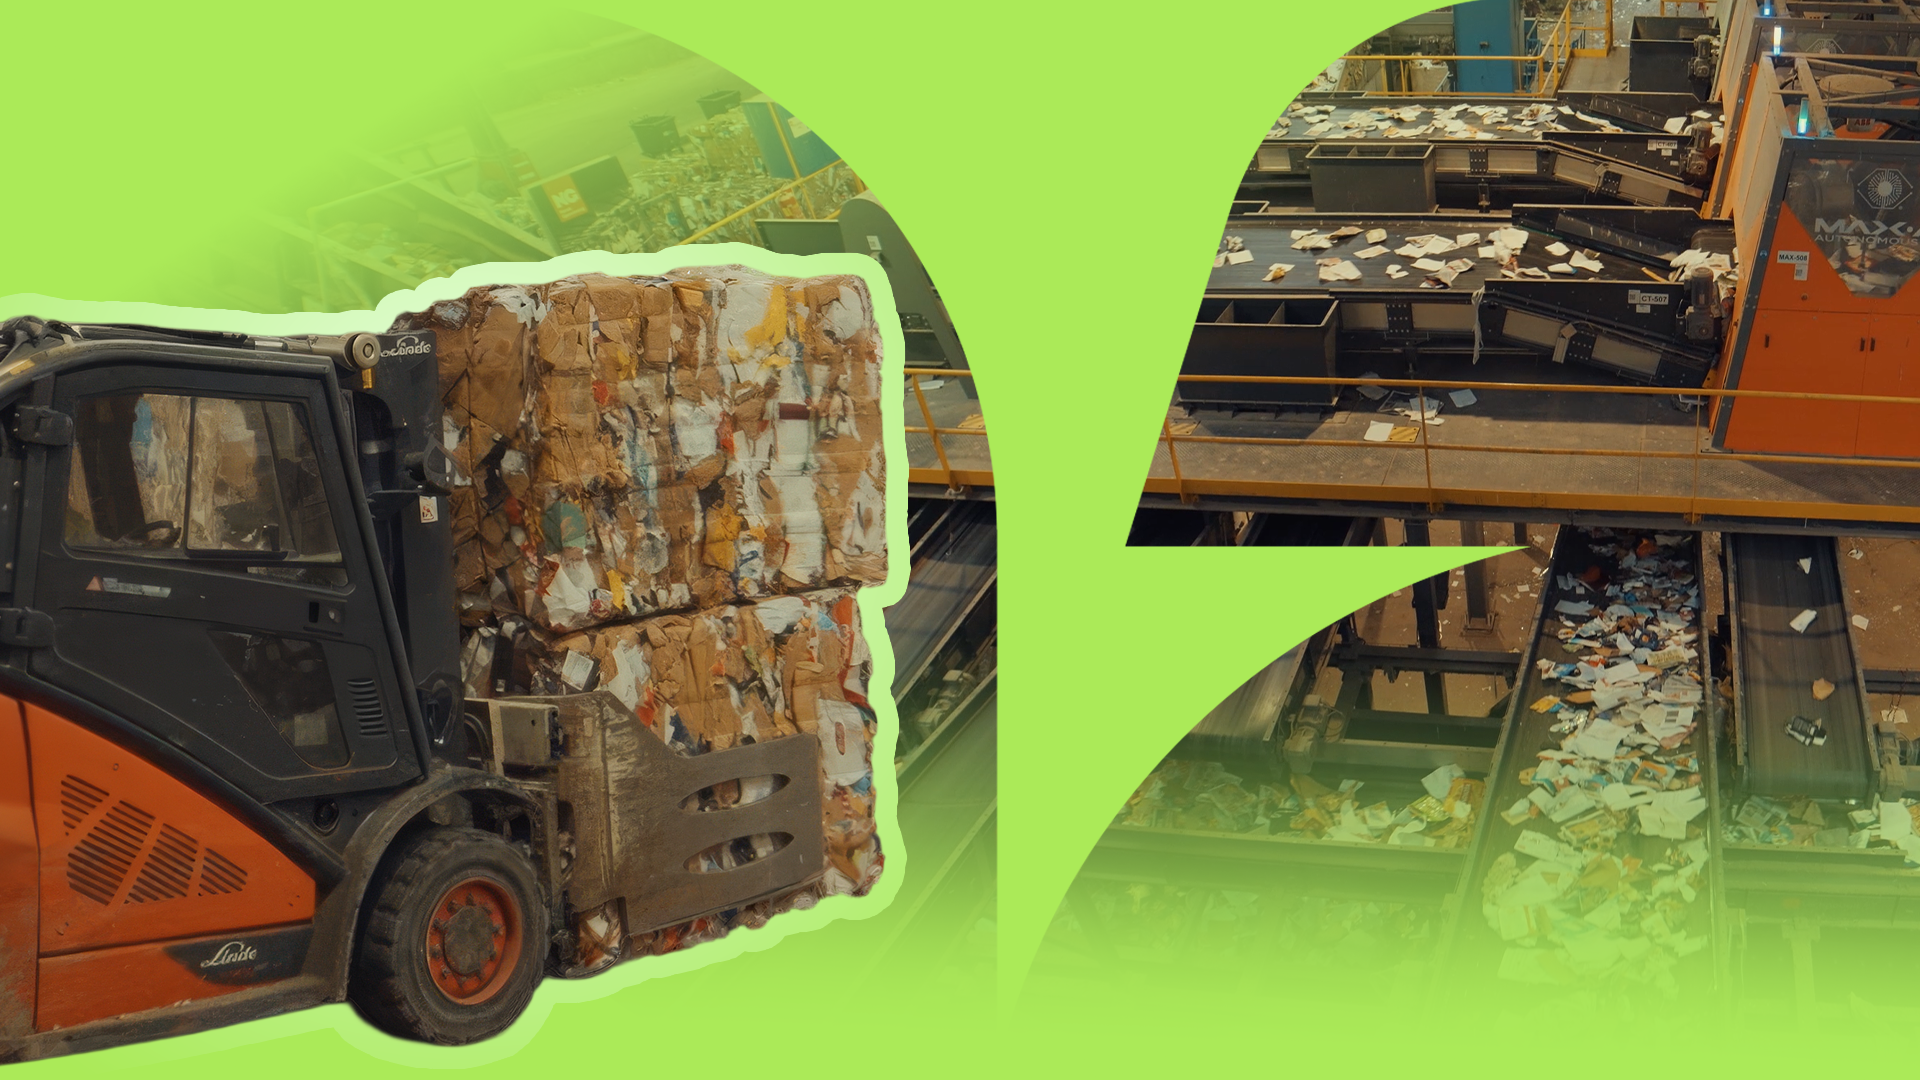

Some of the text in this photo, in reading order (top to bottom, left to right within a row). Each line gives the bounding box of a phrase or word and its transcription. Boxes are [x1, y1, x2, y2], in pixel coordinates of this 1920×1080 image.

[1814, 234, 1919, 246] AUTONOMOUS
[1641, 295, 1668, 303] CT-507
[200, 941, 258, 968] Linde
